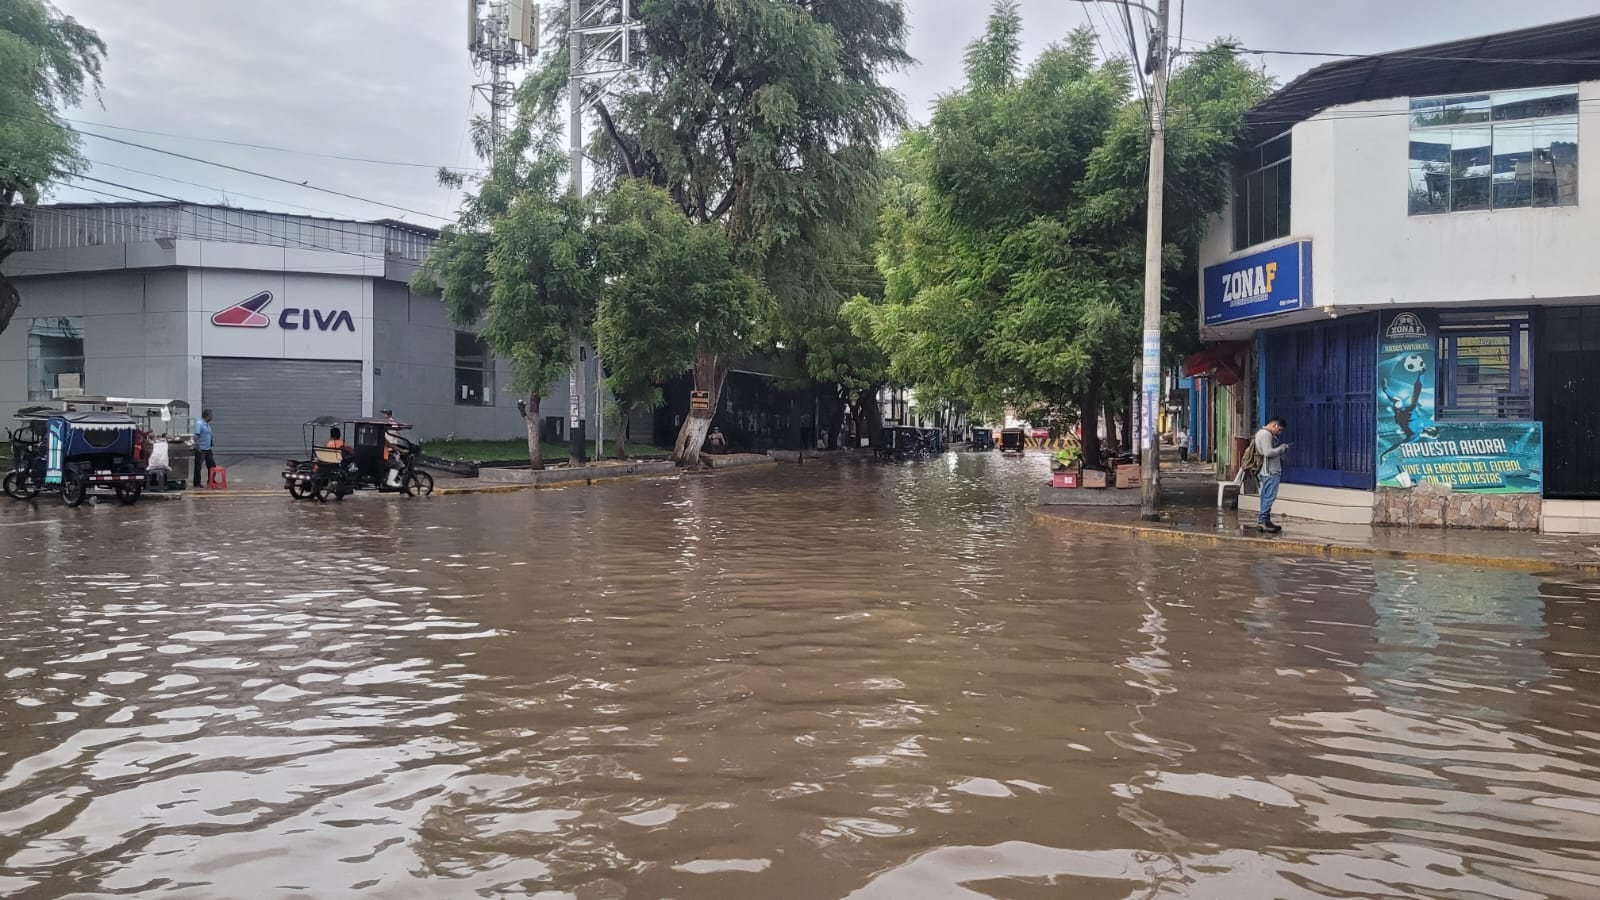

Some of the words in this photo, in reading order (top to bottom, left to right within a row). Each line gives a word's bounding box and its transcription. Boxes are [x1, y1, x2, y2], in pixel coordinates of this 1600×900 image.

[278, 308, 355, 332] CIVA
[1391, 325, 1414, 334] ZONA
[1459, 438, 1507, 455] AHORA!
[1402, 464, 1421, 475] VIVE
[1422, 463, 1433, 474] LA
[1434, 461, 1472, 474] EMOCIÓN
[1473, 462, 1489, 473] DEL
[1441, 474, 1457, 485] TUS
[1459, 473, 1502, 485] APUESTAS
